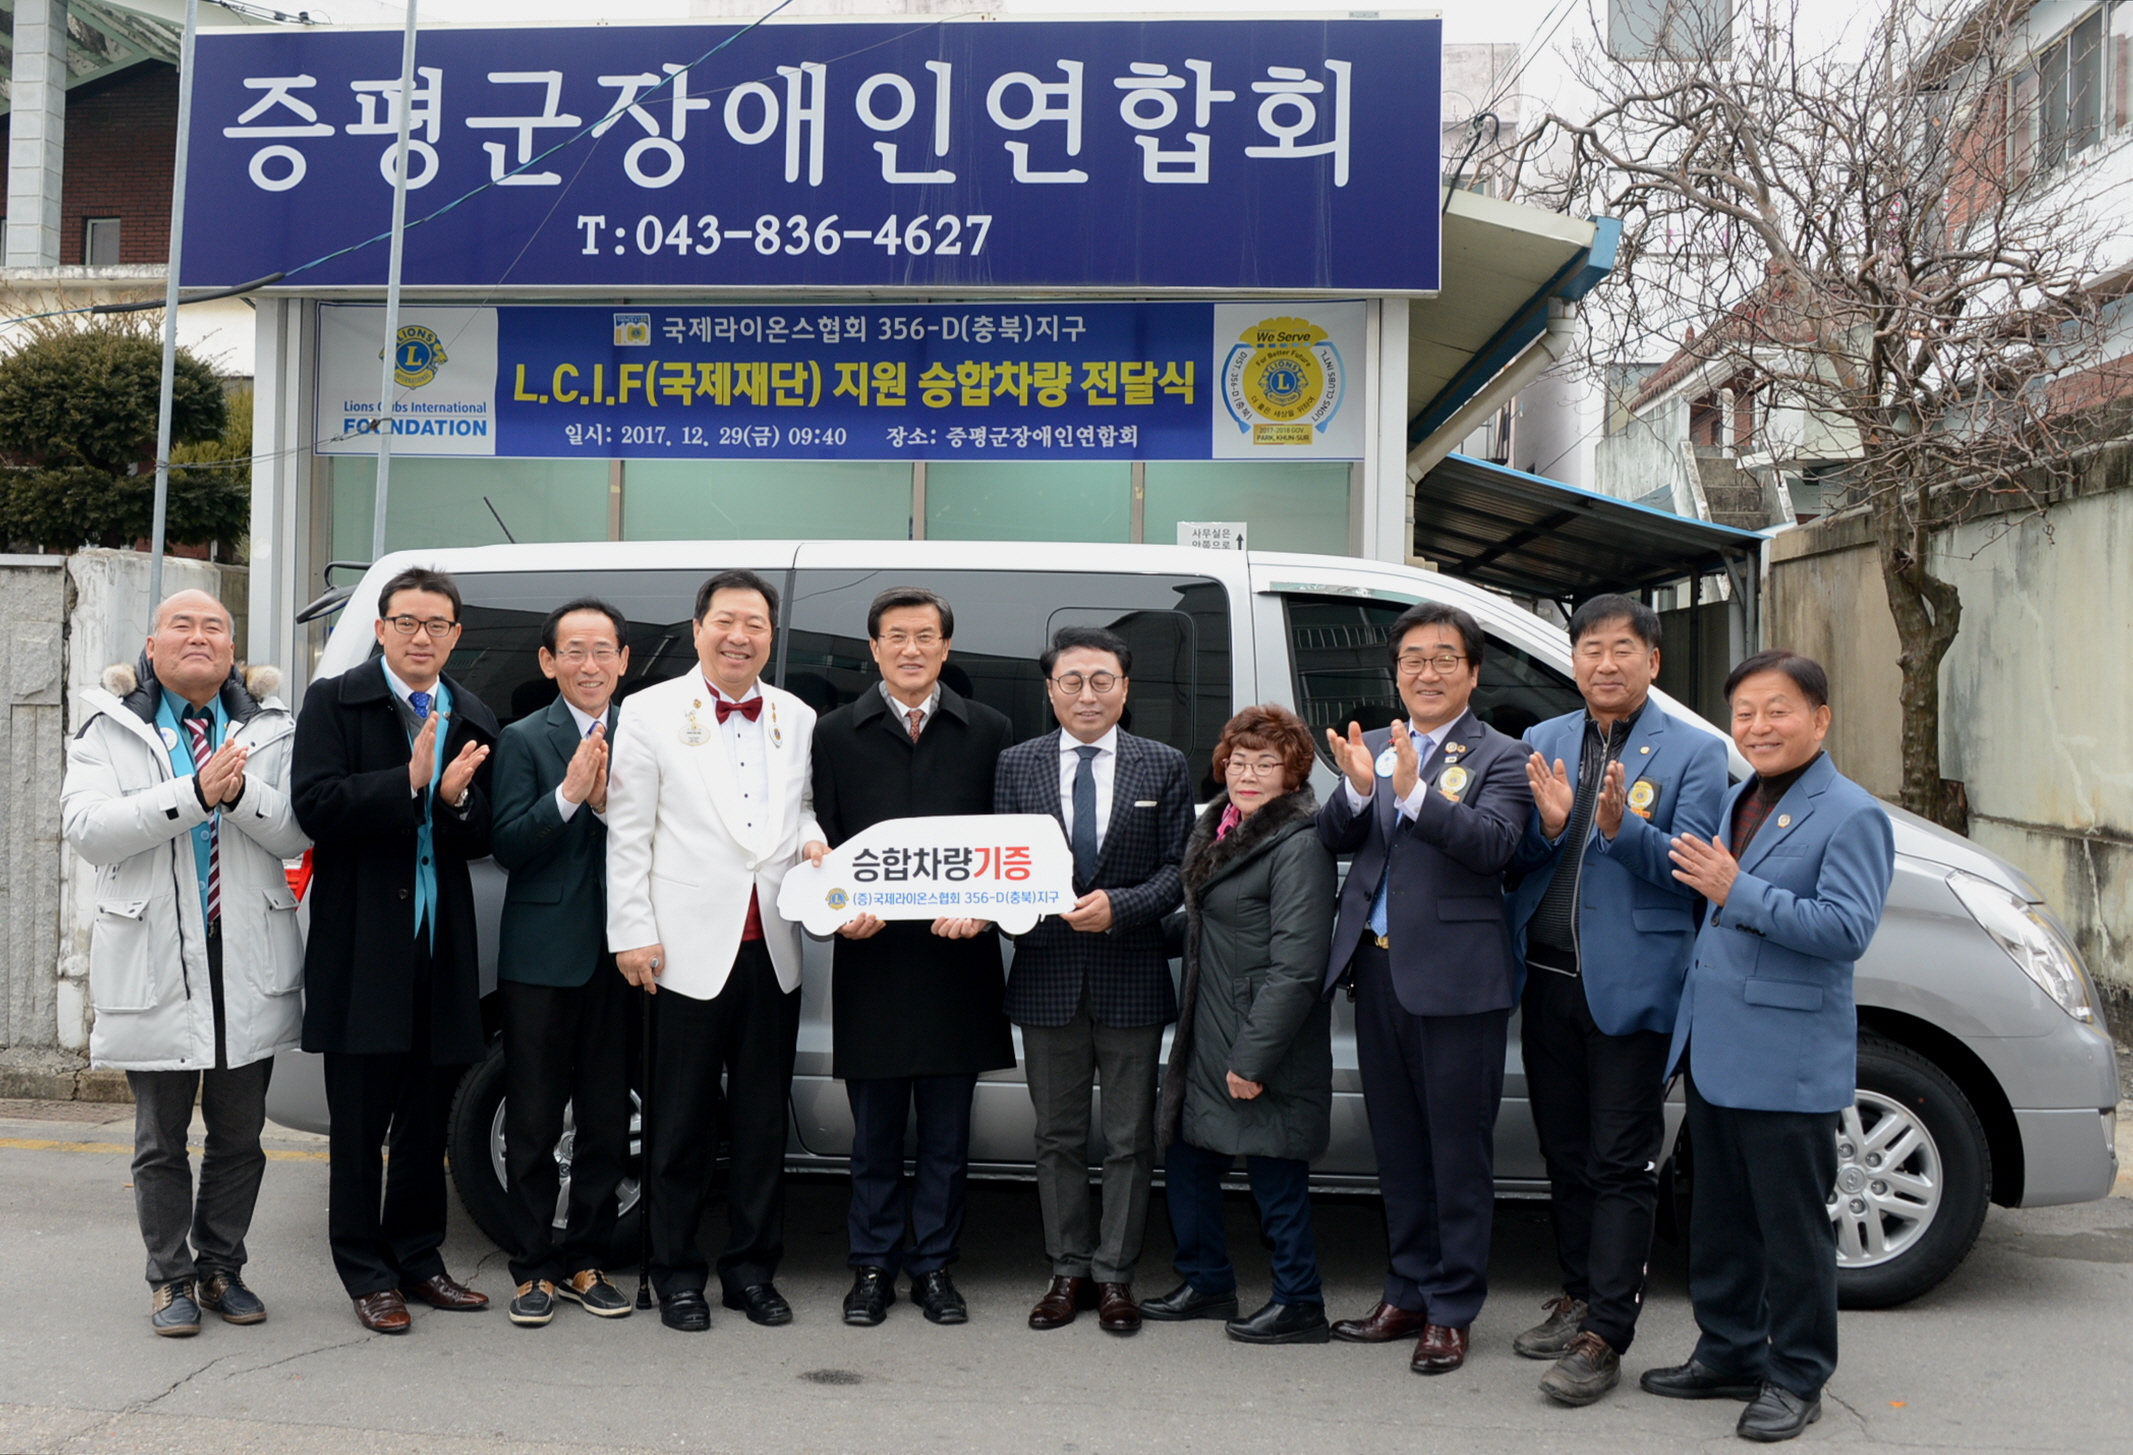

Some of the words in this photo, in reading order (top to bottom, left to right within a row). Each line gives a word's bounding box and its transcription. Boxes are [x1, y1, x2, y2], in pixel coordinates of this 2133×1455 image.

[223, 58, 1352, 192] 증평군장애인연합회
[577, 214, 993, 256] T:043-836-4627
[662, 316, 867, 344] 국제라이온스협회
[878, 315, 1087, 343] 356-D(충북)지구
[1257, 332, 1274, 342] We
[1277, 331, 1311, 342] Serve
[1267, 350, 1290, 359] Better
[1291, 350, 1311, 367] Future
[514, 360, 822, 407] L.C.I.F(국제재단)
[833, 361, 907, 407] 지원
[918, 360, 1072, 408] 승합차량
[1080, 360, 1195, 407] 전달식
[344, 400, 374, 412] Lions
[377, 401, 408, 413] Cbs
[411, 401, 487, 414] International
[1311, 400, 1331, 422] LIONS
[1326, 372, 1336, 399] CLUBS
[344, 418, 487, 436] FONDATION
[564, 423, 613, 446] 일시:
[620, 426, 672, 447] 2017.
[681, 427, 710, 447] 12.
[719, 425, 780, 448] 29(금)
[788, 426, 847, 446] 09:40
[886, 426, 937, 448] 장소:
[945, 425, 1138, 448] 증평군장애인연합회
[965, 890, 1060, 906] 356-D(충북)지구
